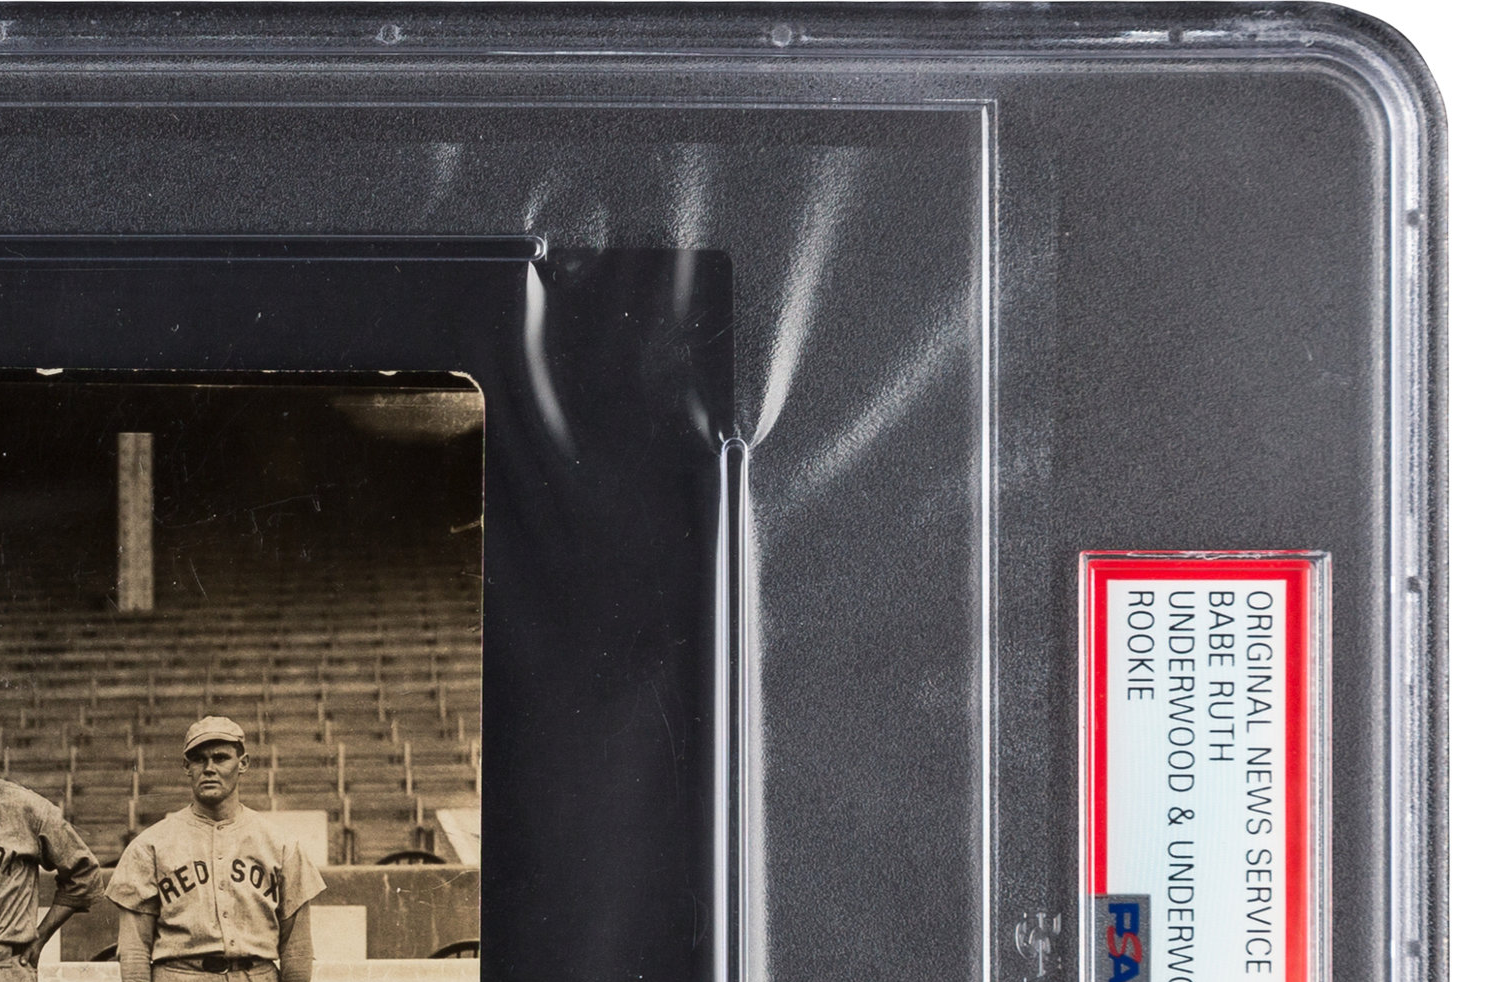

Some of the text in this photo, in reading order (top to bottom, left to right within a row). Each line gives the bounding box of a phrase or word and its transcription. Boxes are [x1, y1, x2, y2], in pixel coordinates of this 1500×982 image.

[1127, 590, 1155, 701] ROOKIE
[1167, 591, 1195, 793] UNDERWOOD
[1208, 591, 1235, 761] BABE RUTH
[1246, 590, 1273, 732] ORIGINAL
[1167, 806, 1195, 826] &
[1246, 747, 1273, 835] NEWS
[158, 858, 278, 904] RED SOX
[1245, 849, 1272, 973] SERVICE
